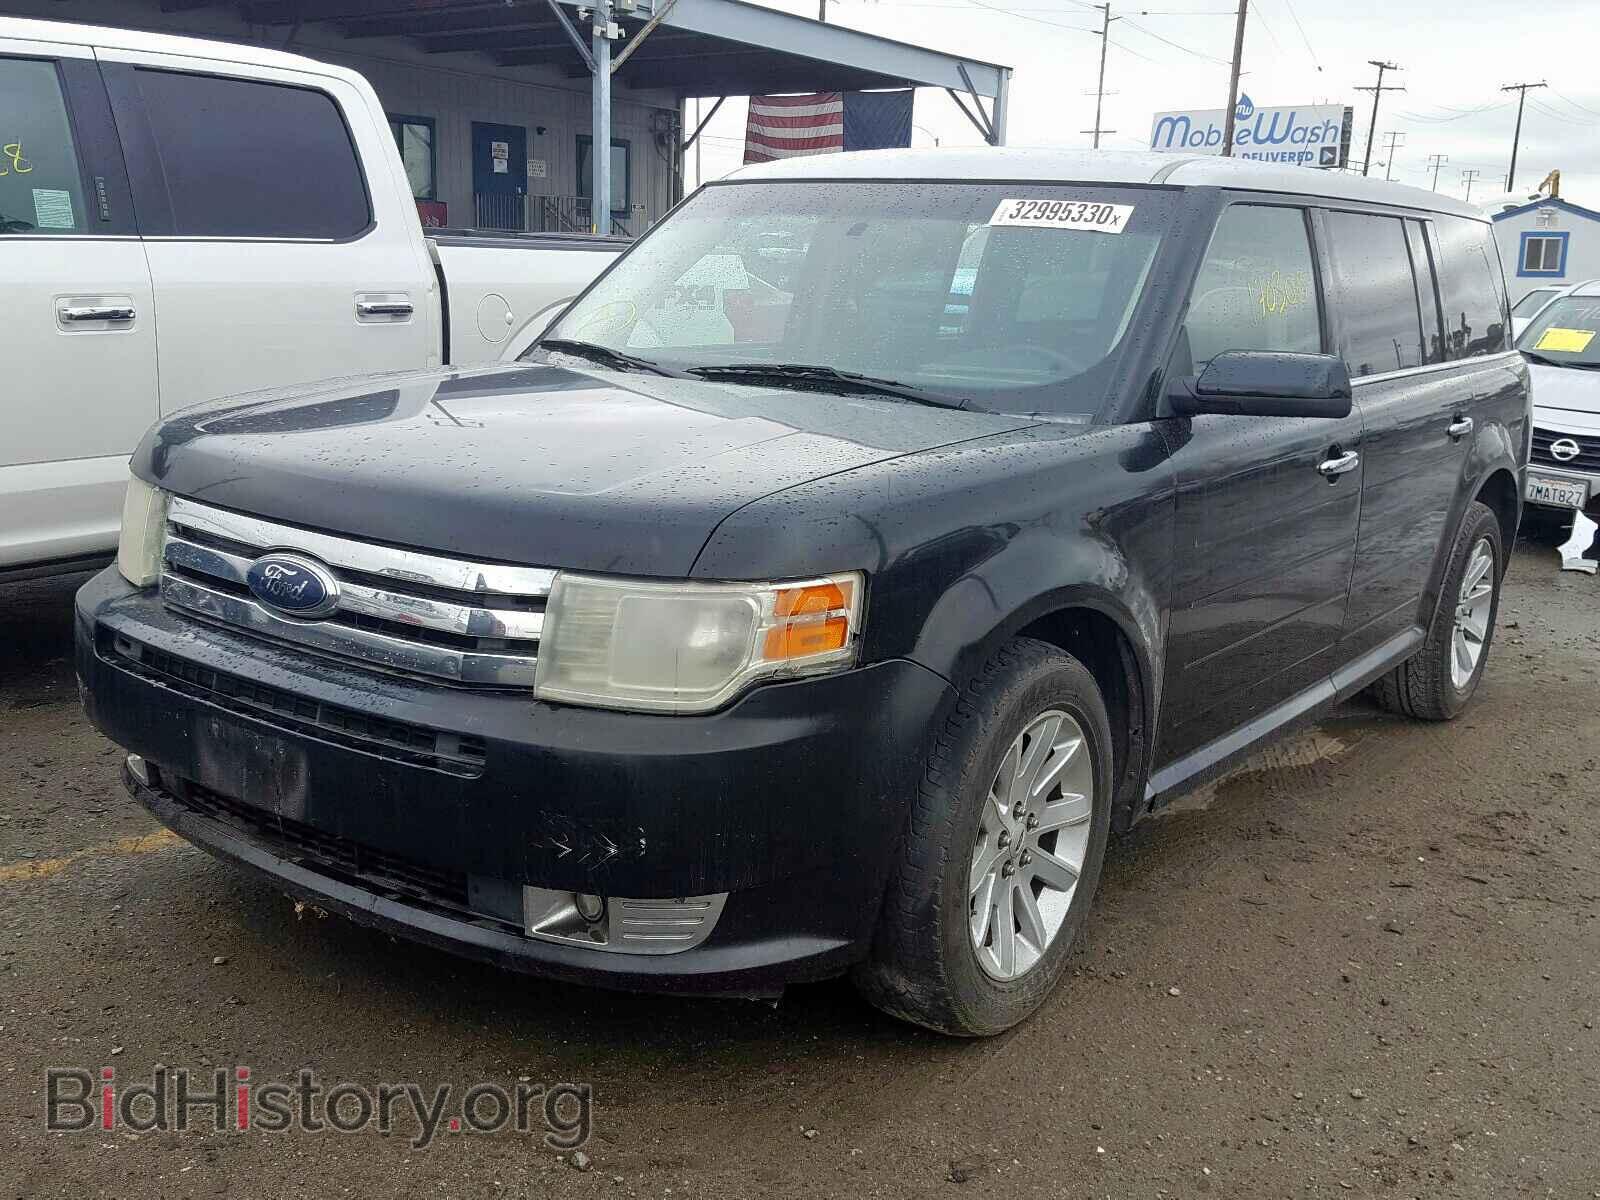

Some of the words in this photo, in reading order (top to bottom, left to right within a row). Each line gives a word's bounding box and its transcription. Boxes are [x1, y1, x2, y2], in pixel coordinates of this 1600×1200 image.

[1152, 112, 1339, 148] MobeWash
[1242, 151, 1314, 163] DELIVERED
[1529, 485, 1583, 505] 7MAT827
[261, 563, 309, 601] Ford
